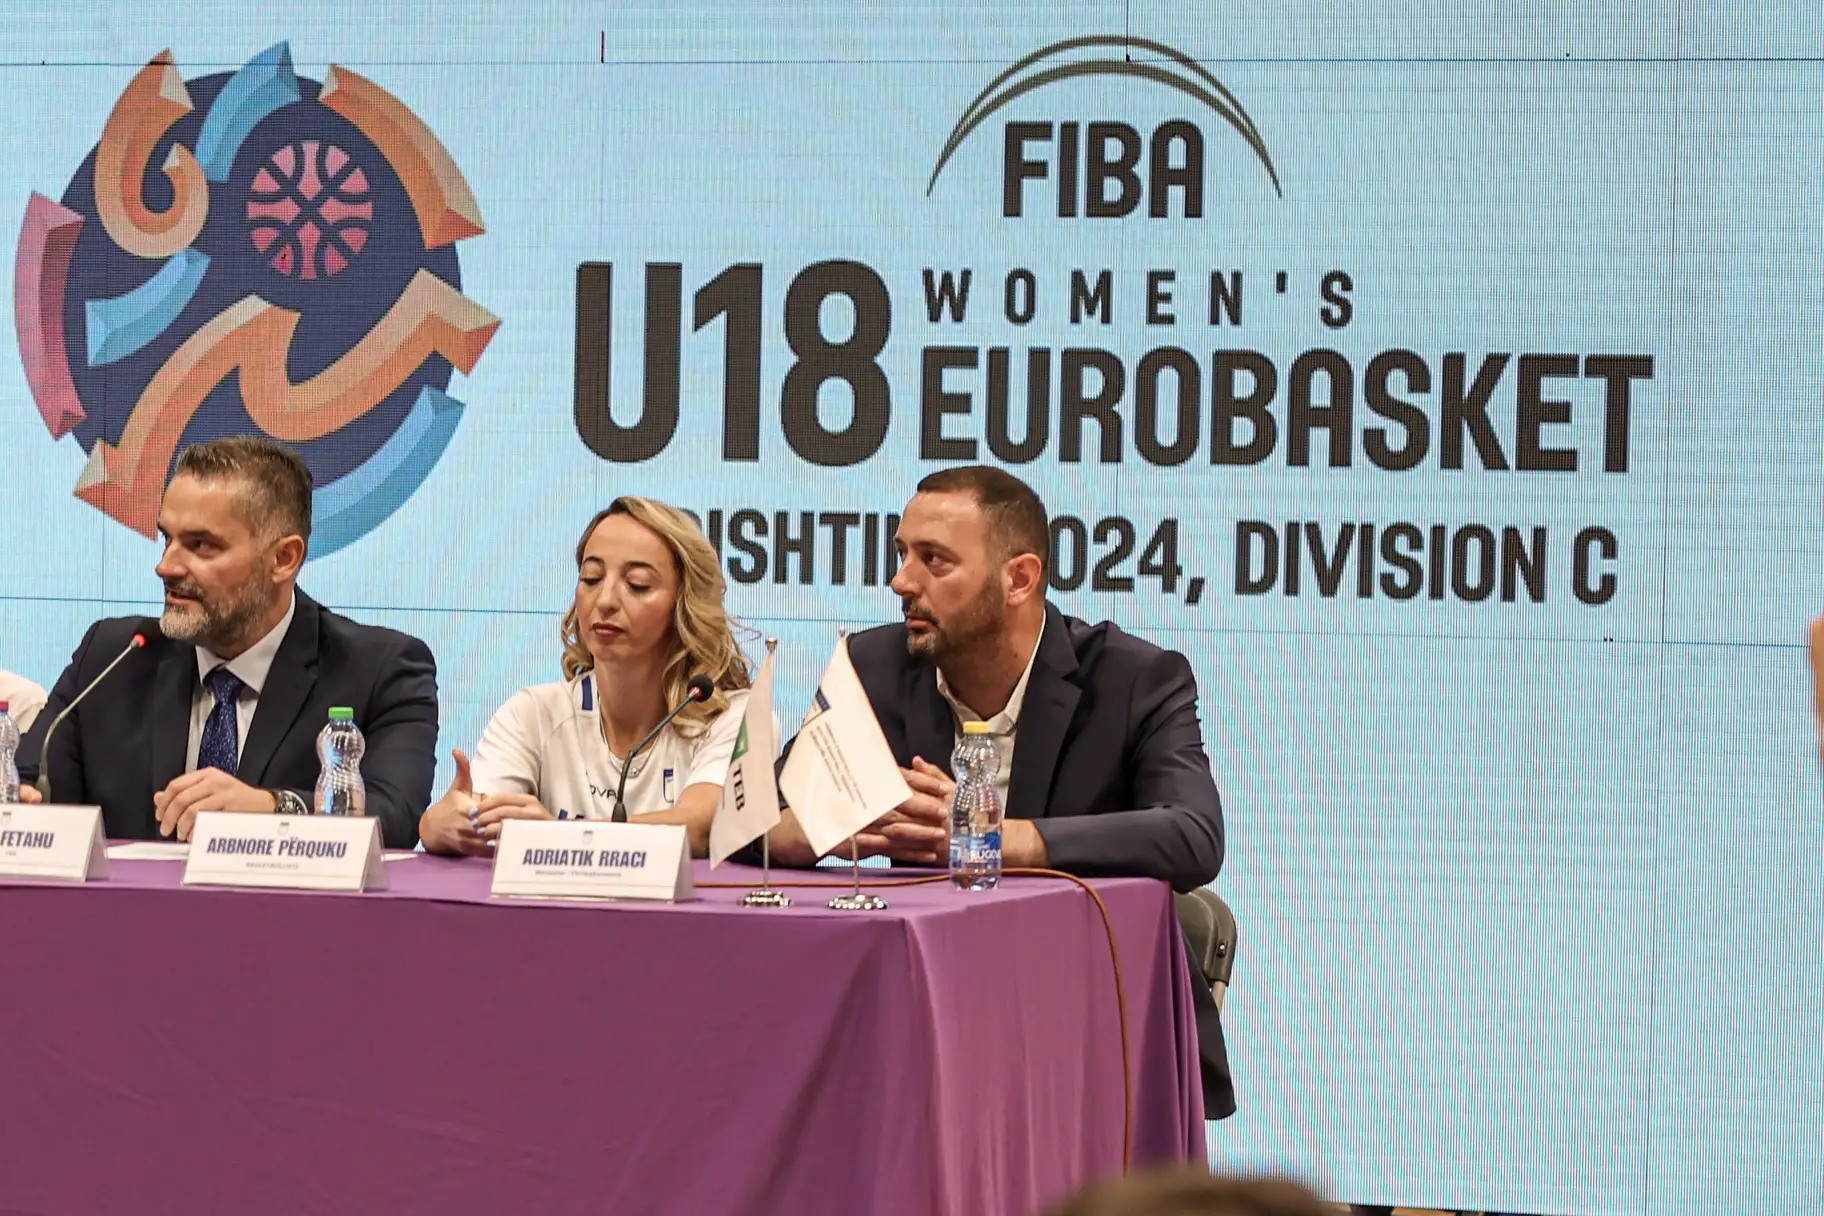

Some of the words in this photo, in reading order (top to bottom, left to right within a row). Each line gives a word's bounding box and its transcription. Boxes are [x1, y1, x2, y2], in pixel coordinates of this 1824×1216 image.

[1003, 120, 1204, 219] FIBA
[922, 268, 1355, 330] WOMEN'S
[574, 259, 892, 467] U18
[919, 345, 1656, 474] EUROBASKET
[678, 508, 903, 587] ISHTI
[1047, 514, 1206, 606] 024,
[1234, 518, 1547, 604] DIVISION
[1572, 525, 1619, 606] C
[732, 763, 746, 812] TEB
[0, 830, 55, 849] FETAHU
[206, 837, 275, 856] ARBNORE
[278, 836, 348, 859] PËRQUKU
[522, 848, 594, 867] ADRIATIK
[598, 850, 647, 869] RRACI
